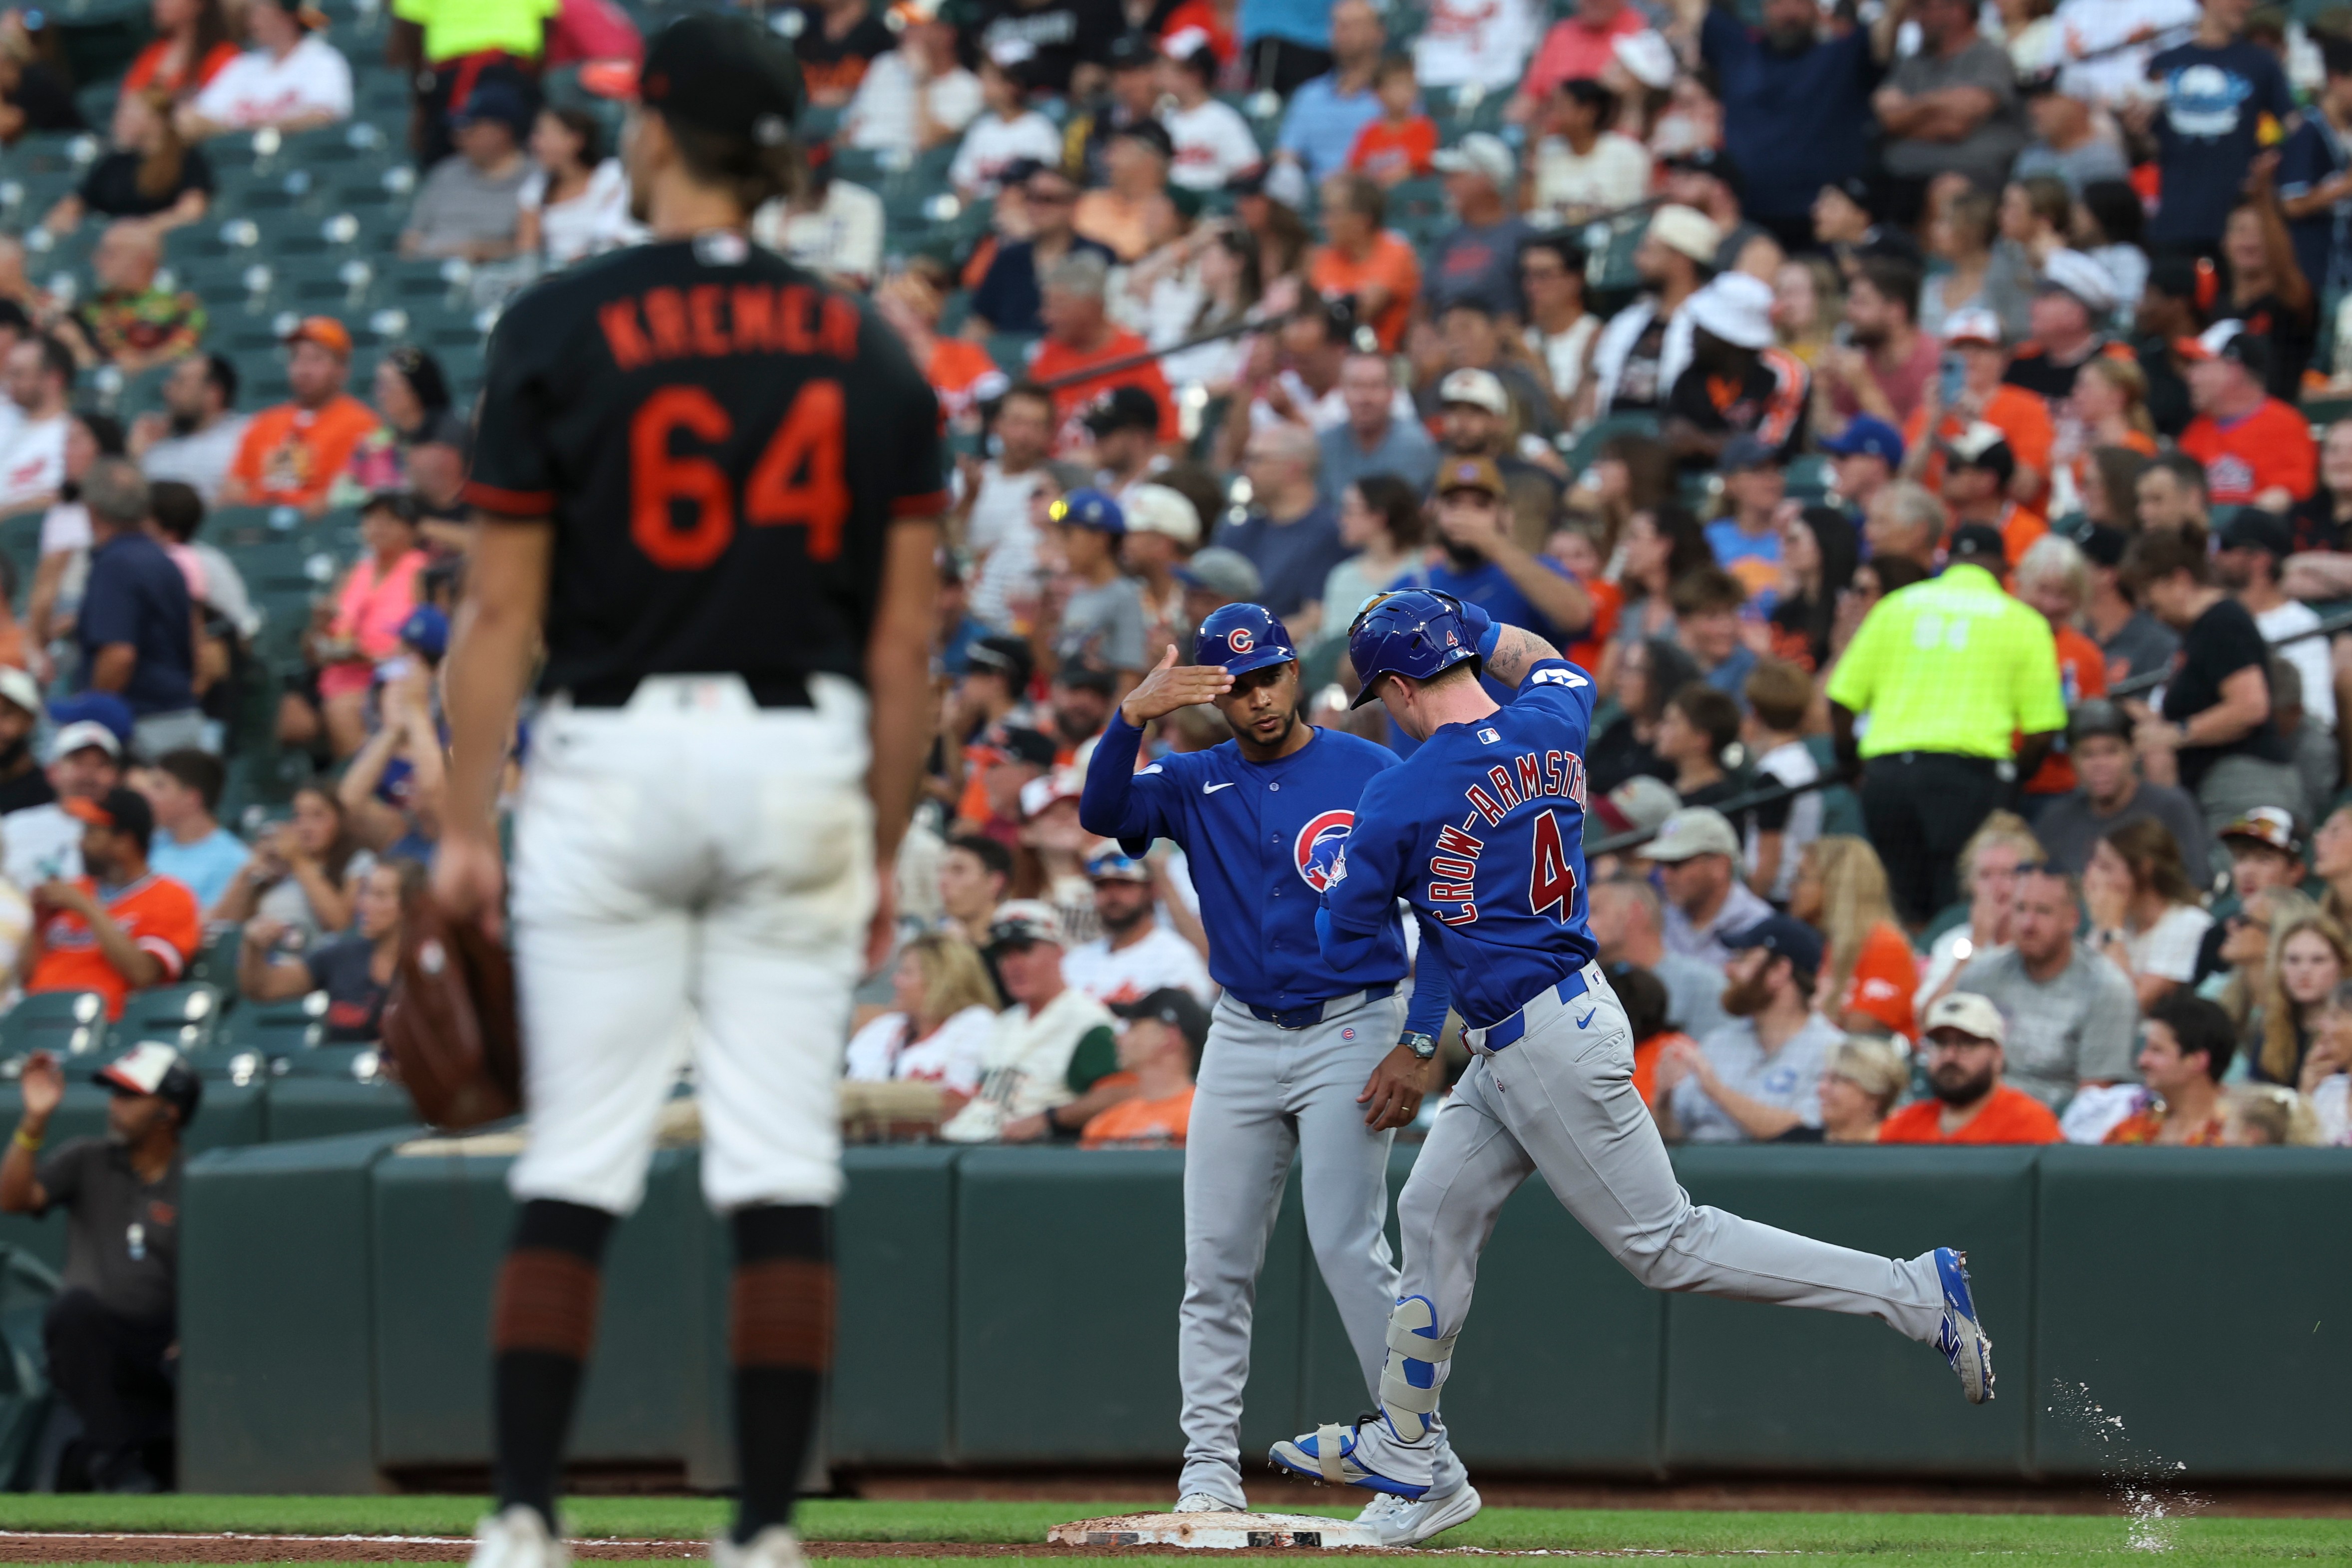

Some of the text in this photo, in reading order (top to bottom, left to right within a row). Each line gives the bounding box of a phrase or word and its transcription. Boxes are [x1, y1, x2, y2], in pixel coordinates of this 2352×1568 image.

[598, 282, 862, 372] KREMER
[629, 377, 853, 572] 64
[1228, 627, 1254, 653] C
[1446, 630, 1458, 646] 4
[1529, 808, 1577, 925] 4
